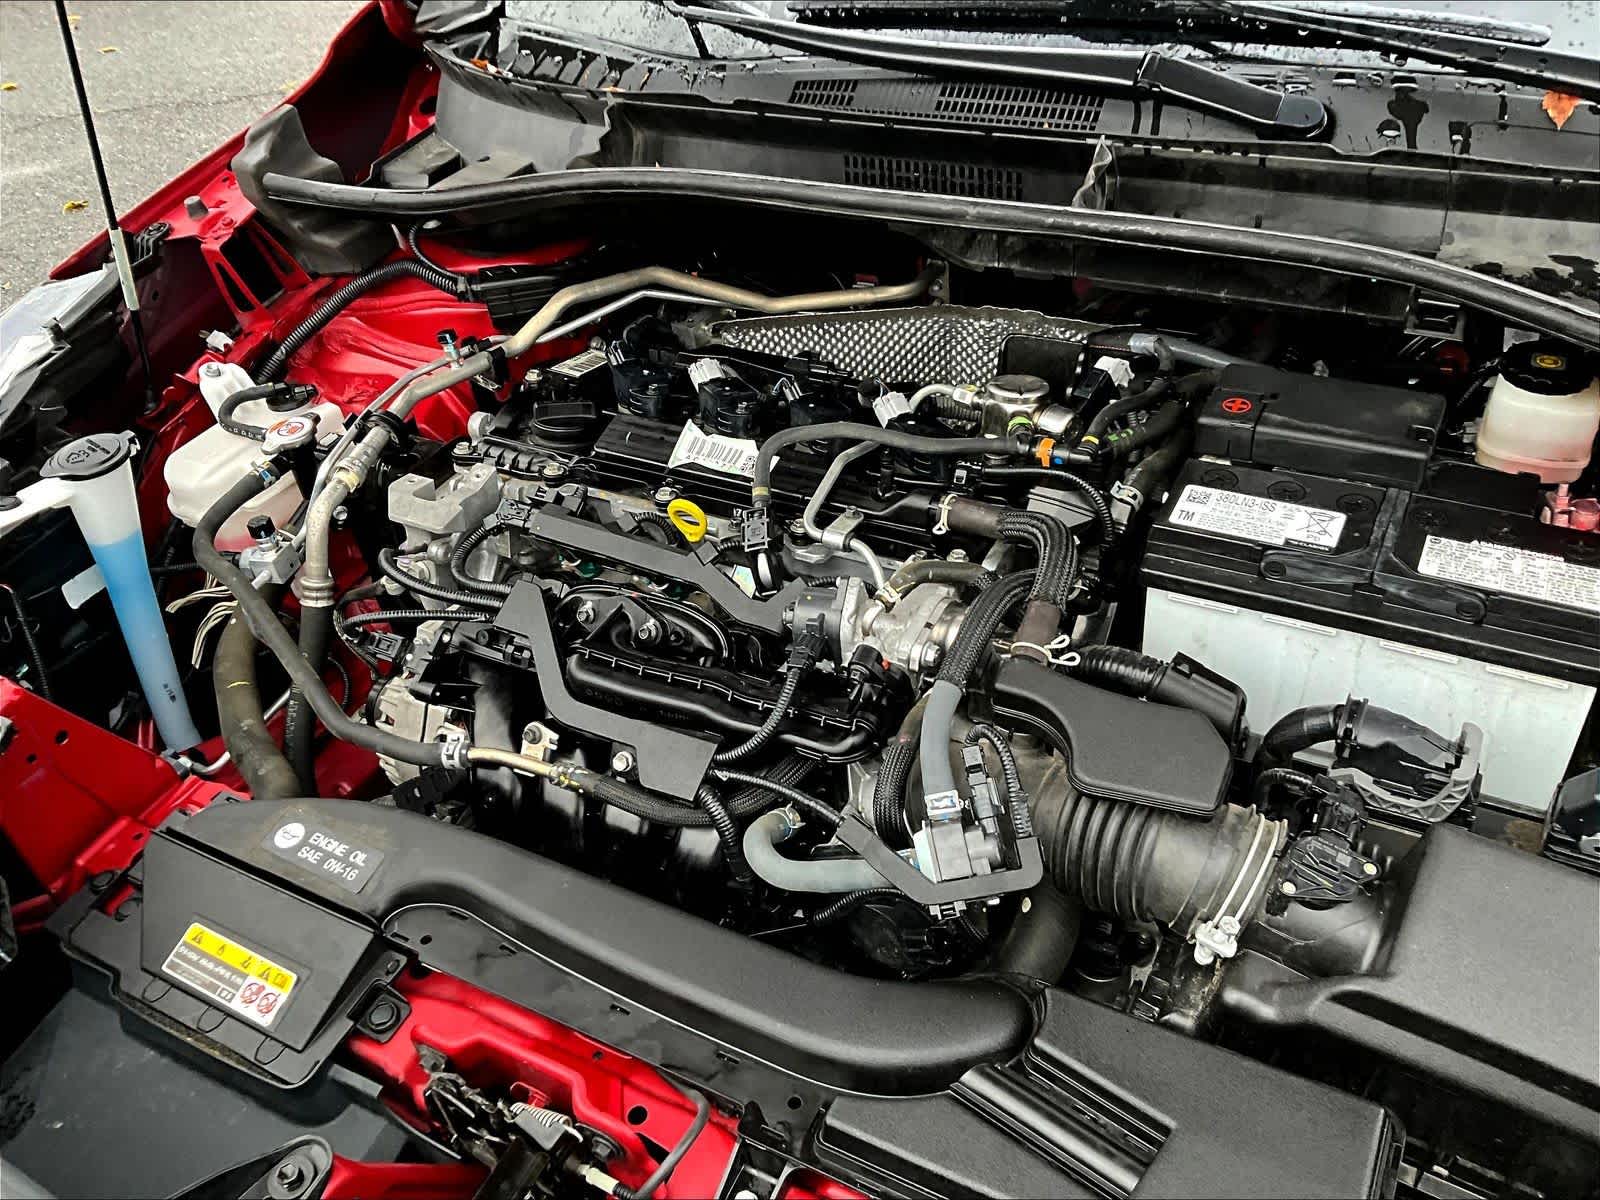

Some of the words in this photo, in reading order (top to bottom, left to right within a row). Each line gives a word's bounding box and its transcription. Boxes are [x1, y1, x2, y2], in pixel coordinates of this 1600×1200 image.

[1177, 509, 1195, 522] TM
[297, 846, 323, 864] SAE
[323, 858, 360, 881] 0W-16
[308, 832, 350, 857] ENGINE
[349, 850, 368, 866] OIL
